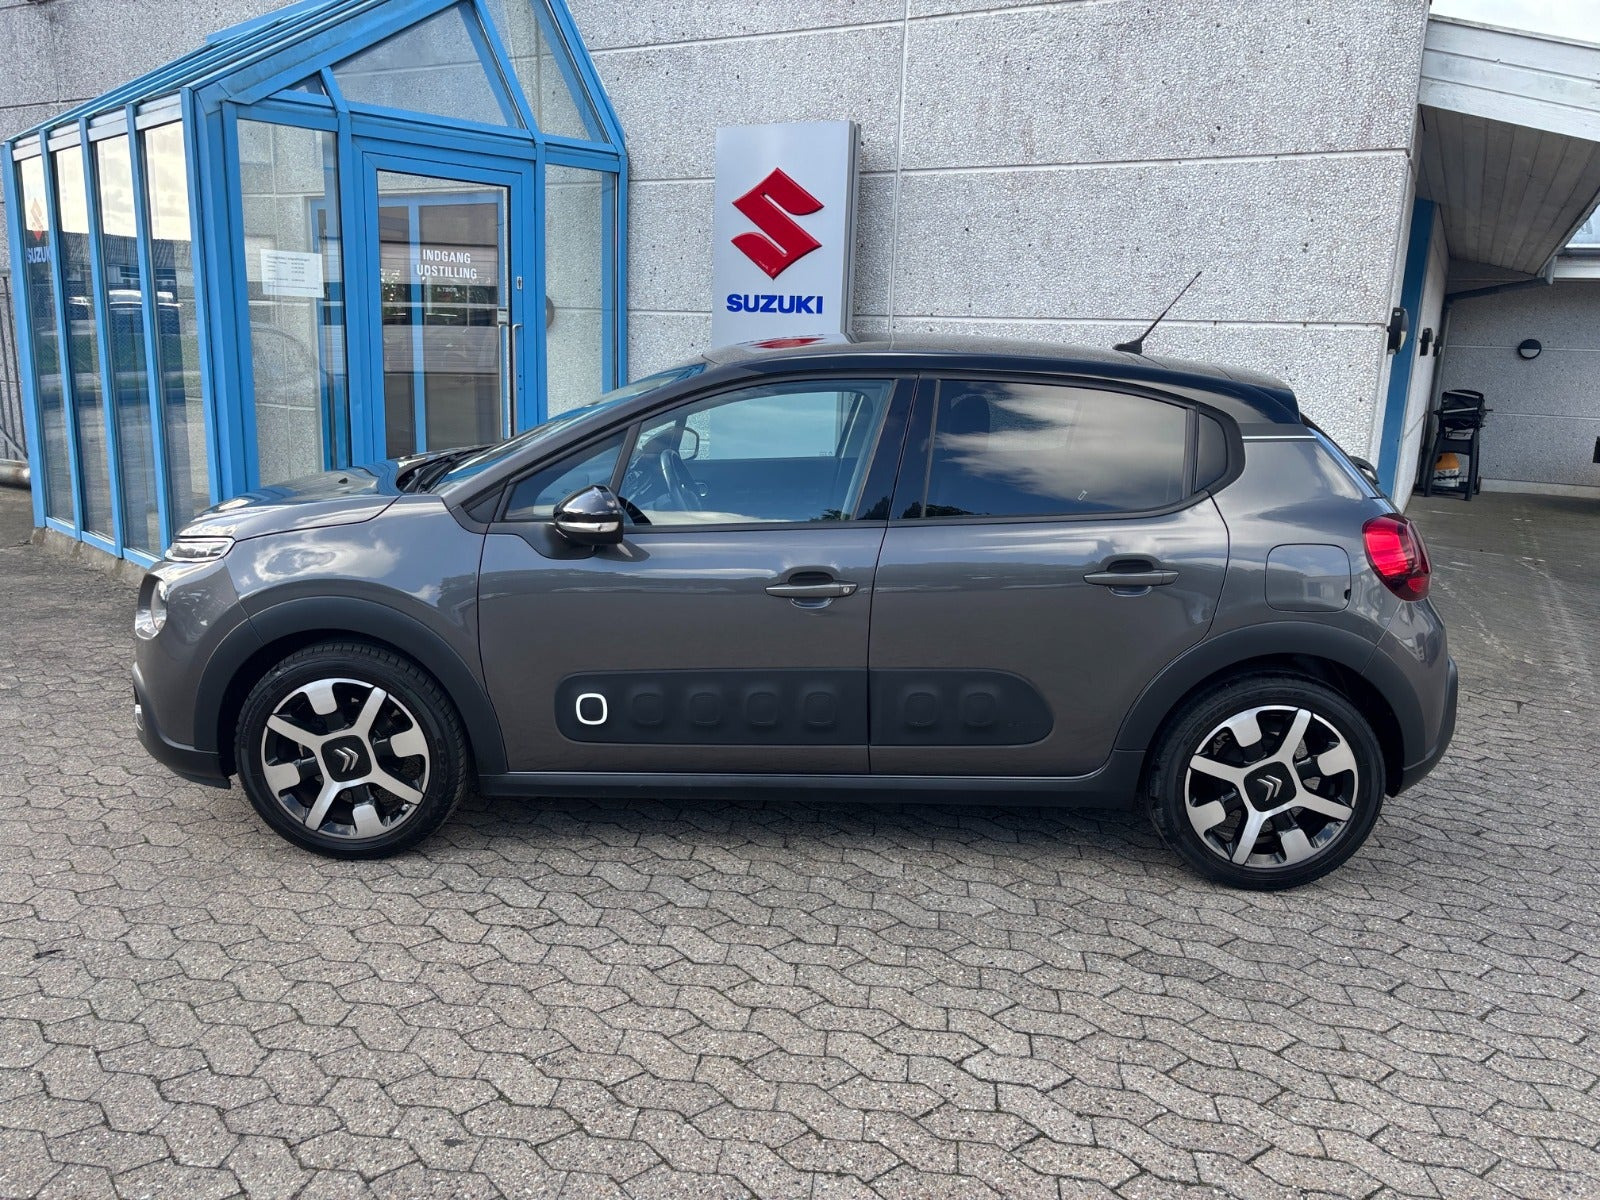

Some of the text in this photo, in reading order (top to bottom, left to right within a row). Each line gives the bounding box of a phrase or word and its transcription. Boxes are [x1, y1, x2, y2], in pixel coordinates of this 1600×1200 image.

[422, 248, 471, 264] INDGANG
[416, 264, 478, 280] UDSTILLING
[726, 293, 824, 315] SUZUKI
